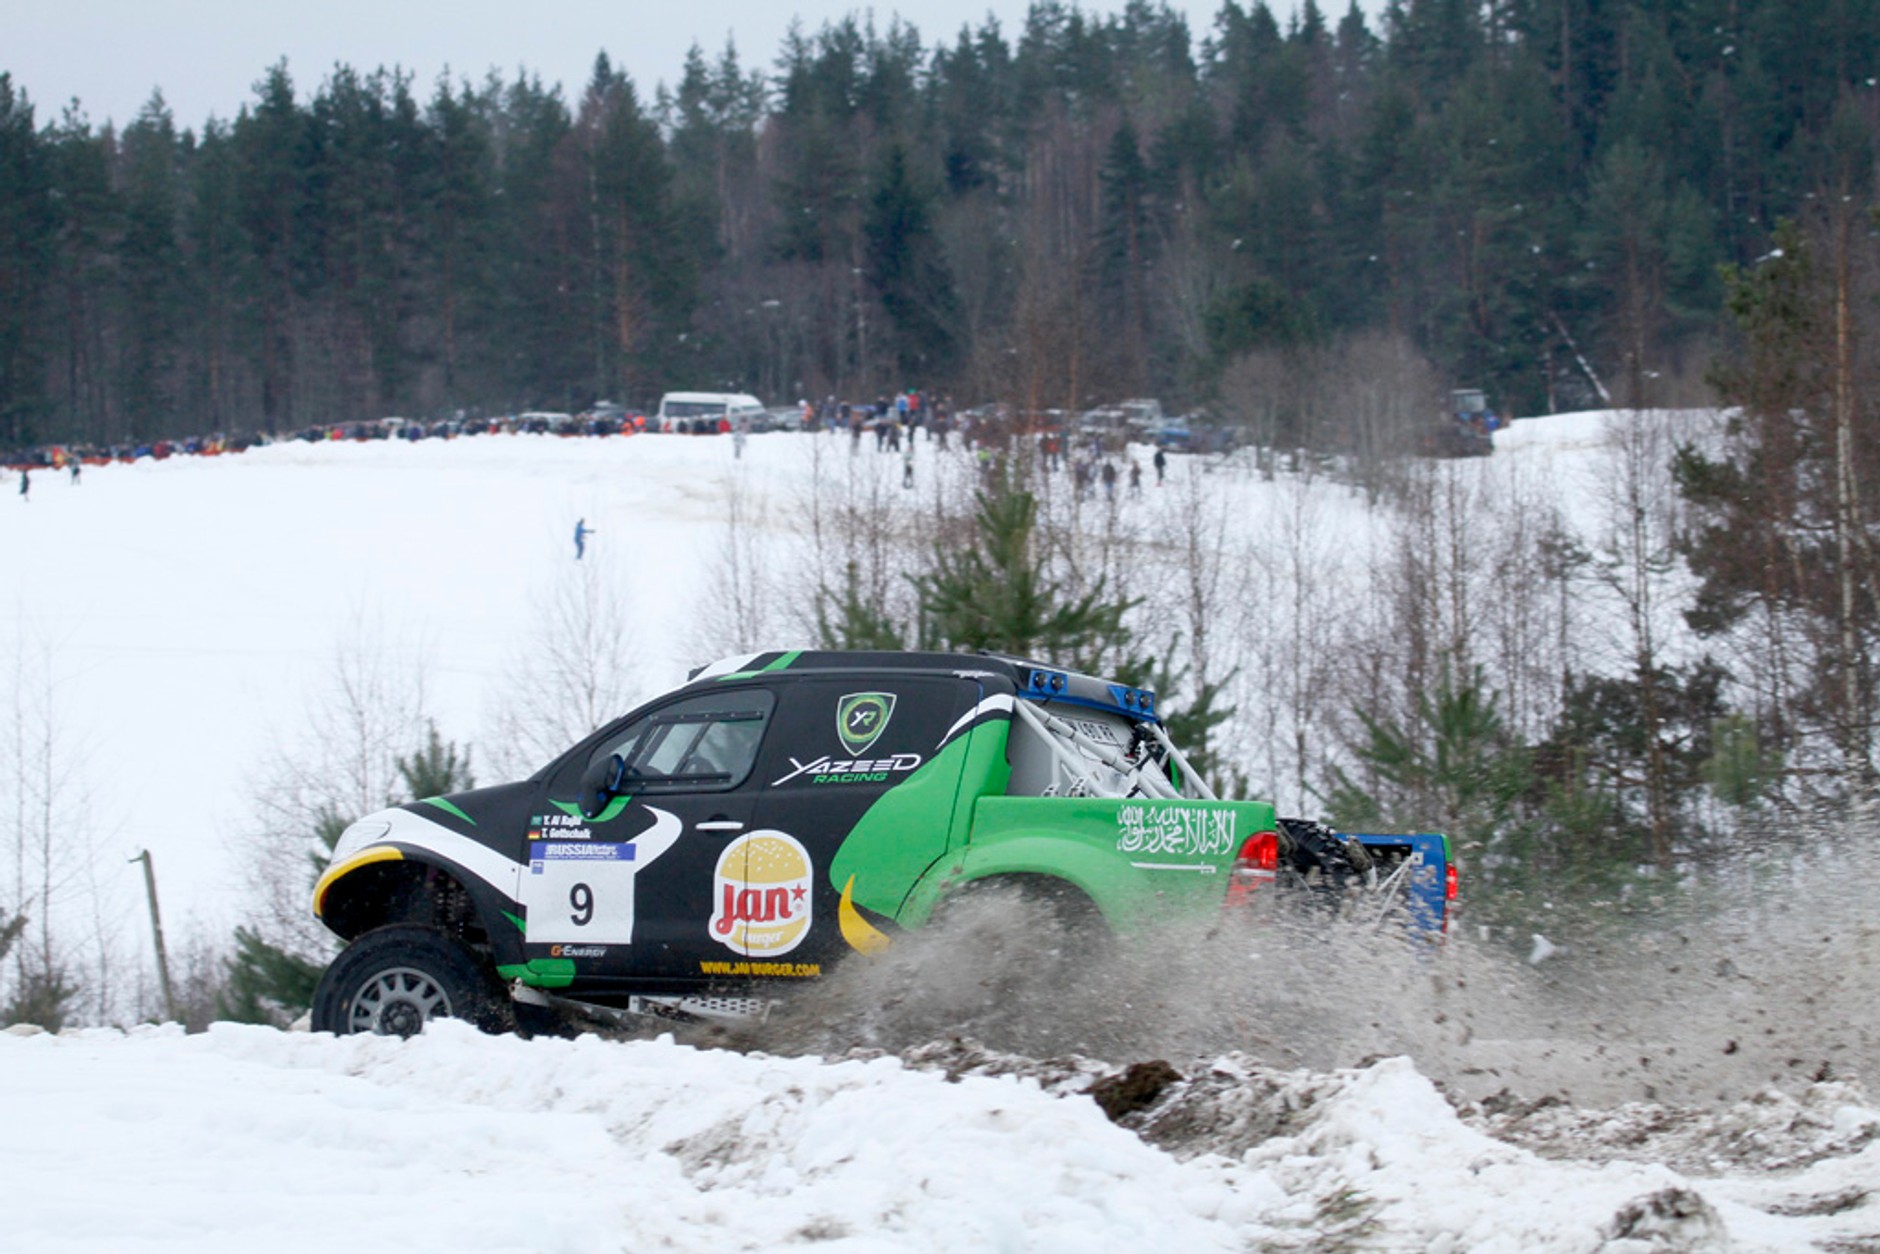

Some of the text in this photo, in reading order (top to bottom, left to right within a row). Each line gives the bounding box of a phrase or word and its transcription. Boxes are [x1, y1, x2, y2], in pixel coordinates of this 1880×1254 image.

[771, 754, 922, 787] YAZEED
[813, 772, 888, 784] RACING
[569, 882, 594, 927] 9
[716, 883, 792, 935] Jan
